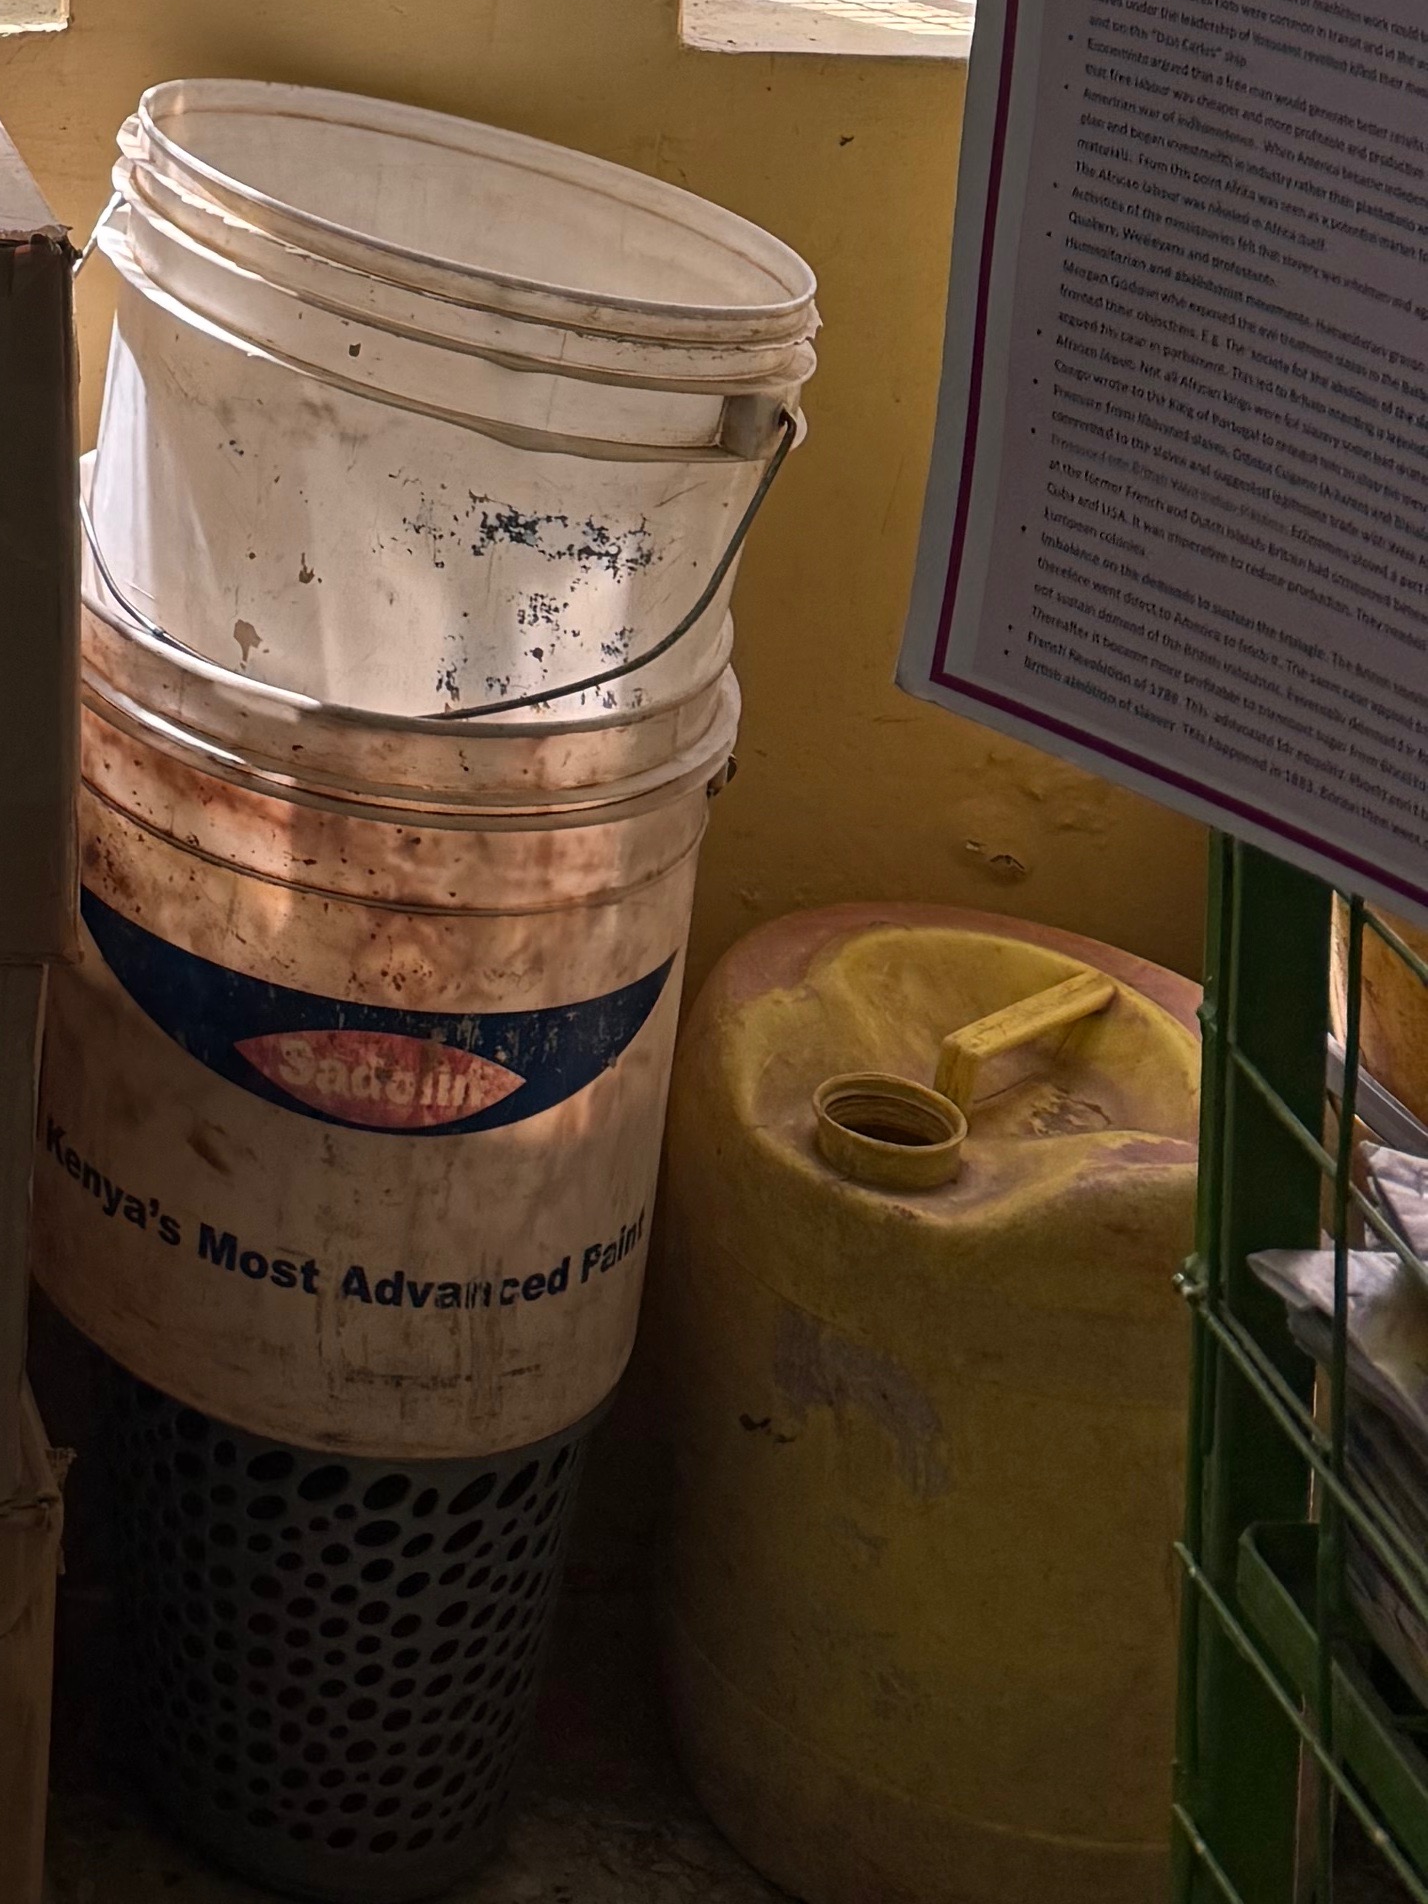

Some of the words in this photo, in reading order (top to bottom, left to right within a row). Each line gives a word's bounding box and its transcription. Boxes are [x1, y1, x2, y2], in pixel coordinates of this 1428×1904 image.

[45, 1116, 183, 1248] Kenya's
[198, 1223, 321, 1296] Most
[342, 1257, 569, 1309] Advanced
